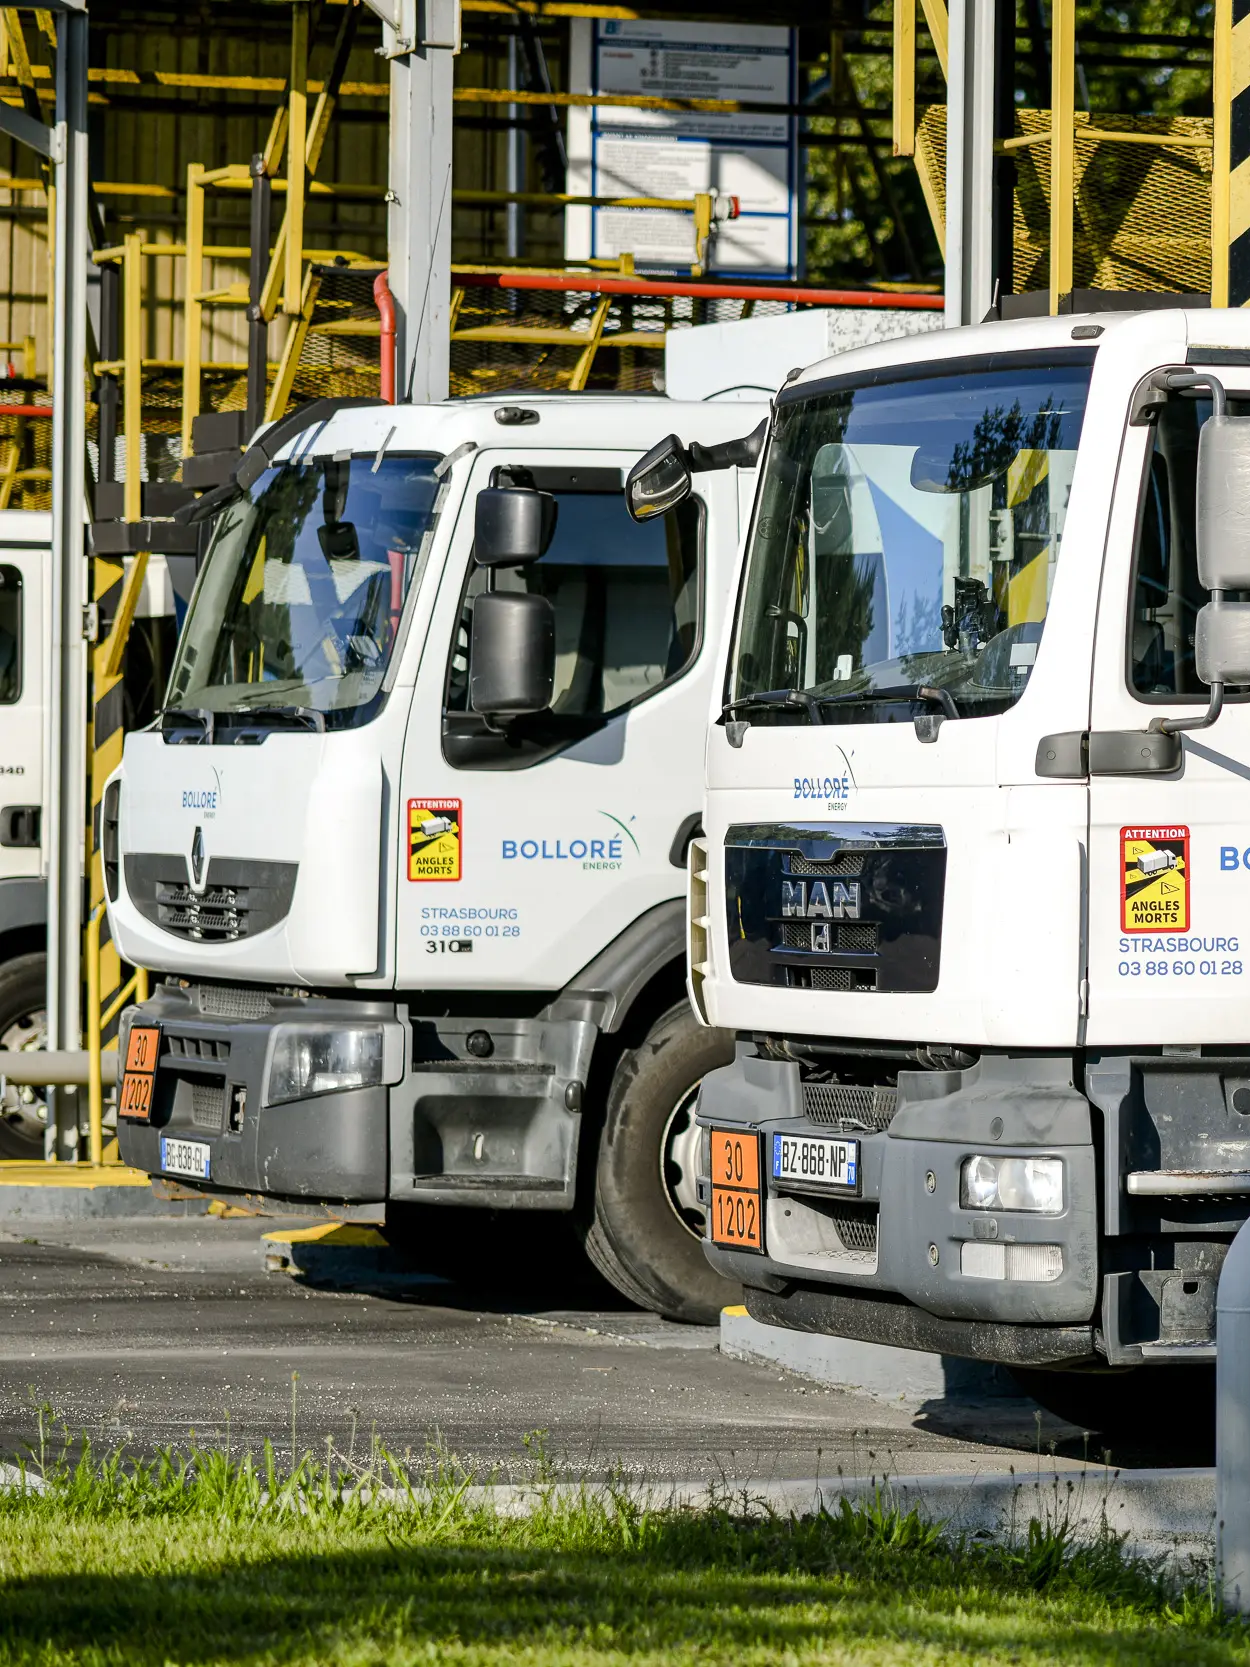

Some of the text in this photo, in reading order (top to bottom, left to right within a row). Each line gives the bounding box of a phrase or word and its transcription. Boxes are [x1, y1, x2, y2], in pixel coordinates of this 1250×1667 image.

[794, 770, 850, 799] BOLLORÉ
[182, 786, 217, 809] BOLLORÉ
[410, 800, 460, 809] ATTENTION
[827, 802, 848, 811] ENERGY
[1125, 829, 1186, 838] ATTENTION
[502, 832, 623, 859] BOLLORÉ
[415, 857, 454, 866] ANGLES
[582, 861, 623, 871] ENERGY
[417, 866, 453, 875] MORTS
[782, 881, 861, 919] MAN
[1131, 900, 1180, 912] ANGLES
[421, 907, 518, 920] STRASBOURG
[1134, 912, 1178, 924] MORTS
[420, 924, 521, 937] 03 88 60 01 28
[425, 940, 460, 953] 310
[1119, 937, 1239, 953] STRASBOURG
[1118, 960, 1243, 976] 03 88 60 01 28
[134, 1034, 148, 1067] 30
[124, 1078, 150, 1112] 1202
[724, 1139, 743, 1182] 30
[782, 1141, 847, 1178] BZ-868-NP
[718, 1194, 756, 1240] 1202
